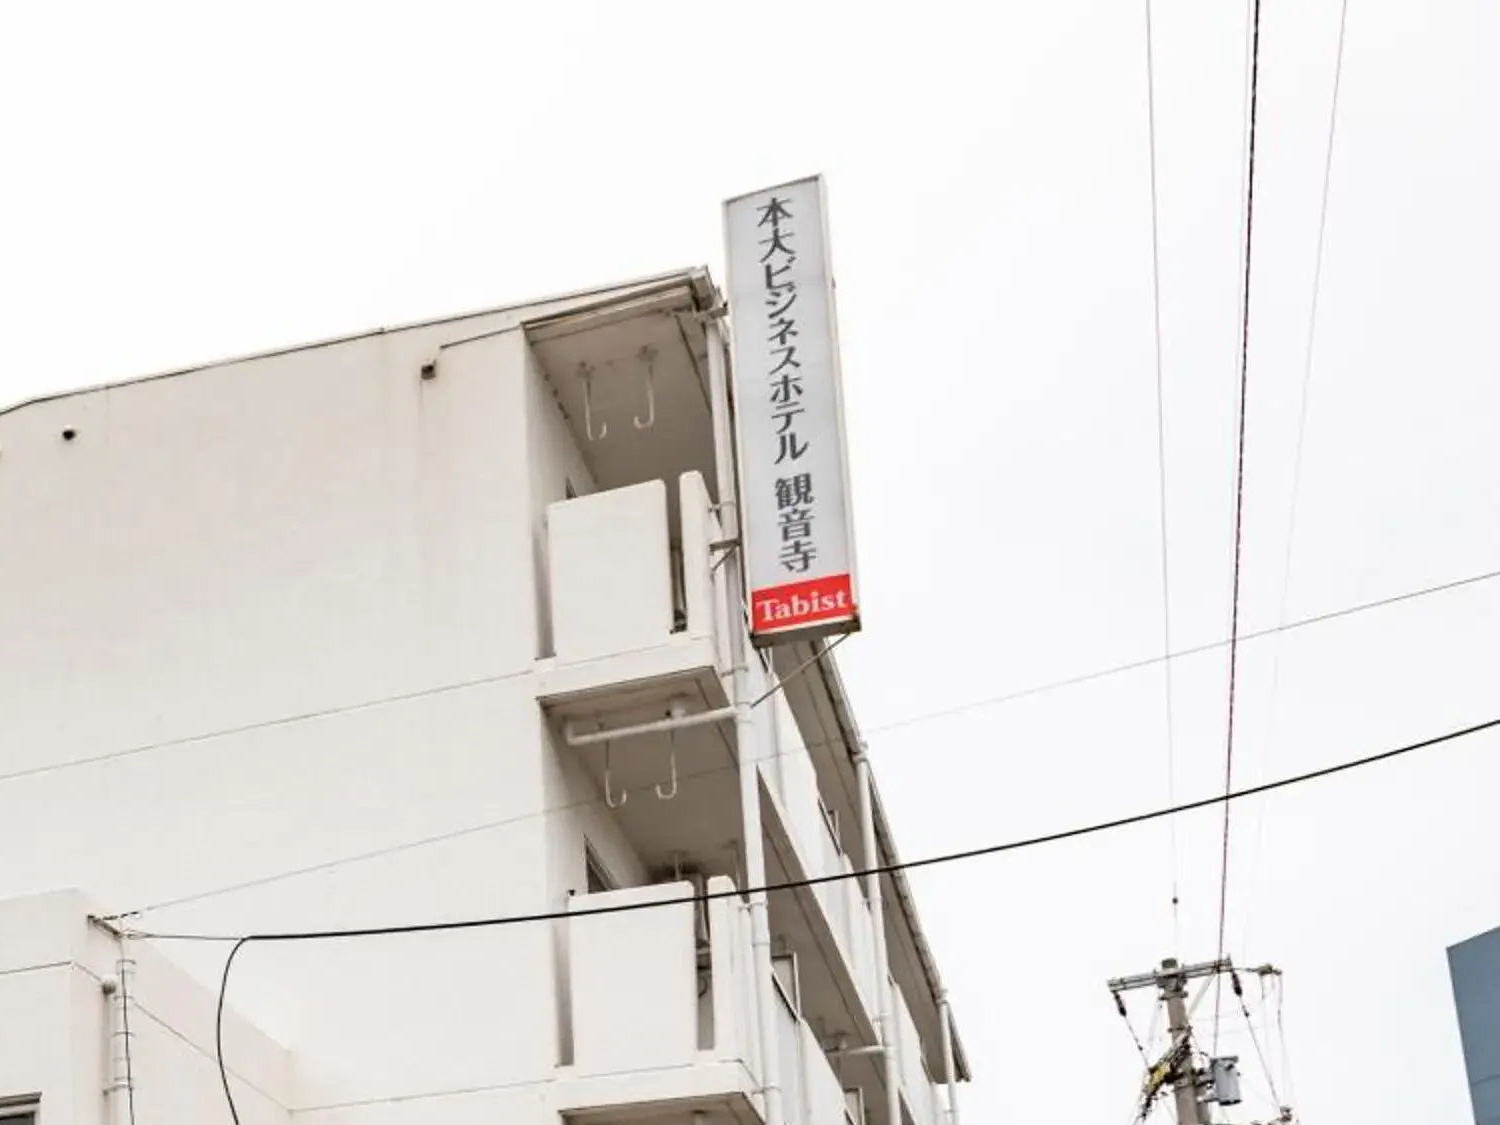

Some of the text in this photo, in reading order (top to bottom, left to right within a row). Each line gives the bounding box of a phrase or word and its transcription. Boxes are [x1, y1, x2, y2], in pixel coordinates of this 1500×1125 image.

[756, 197, 818, 573] 本大ビジネスホテル 観音寺
[757, 587, 849, 624] Tabist
